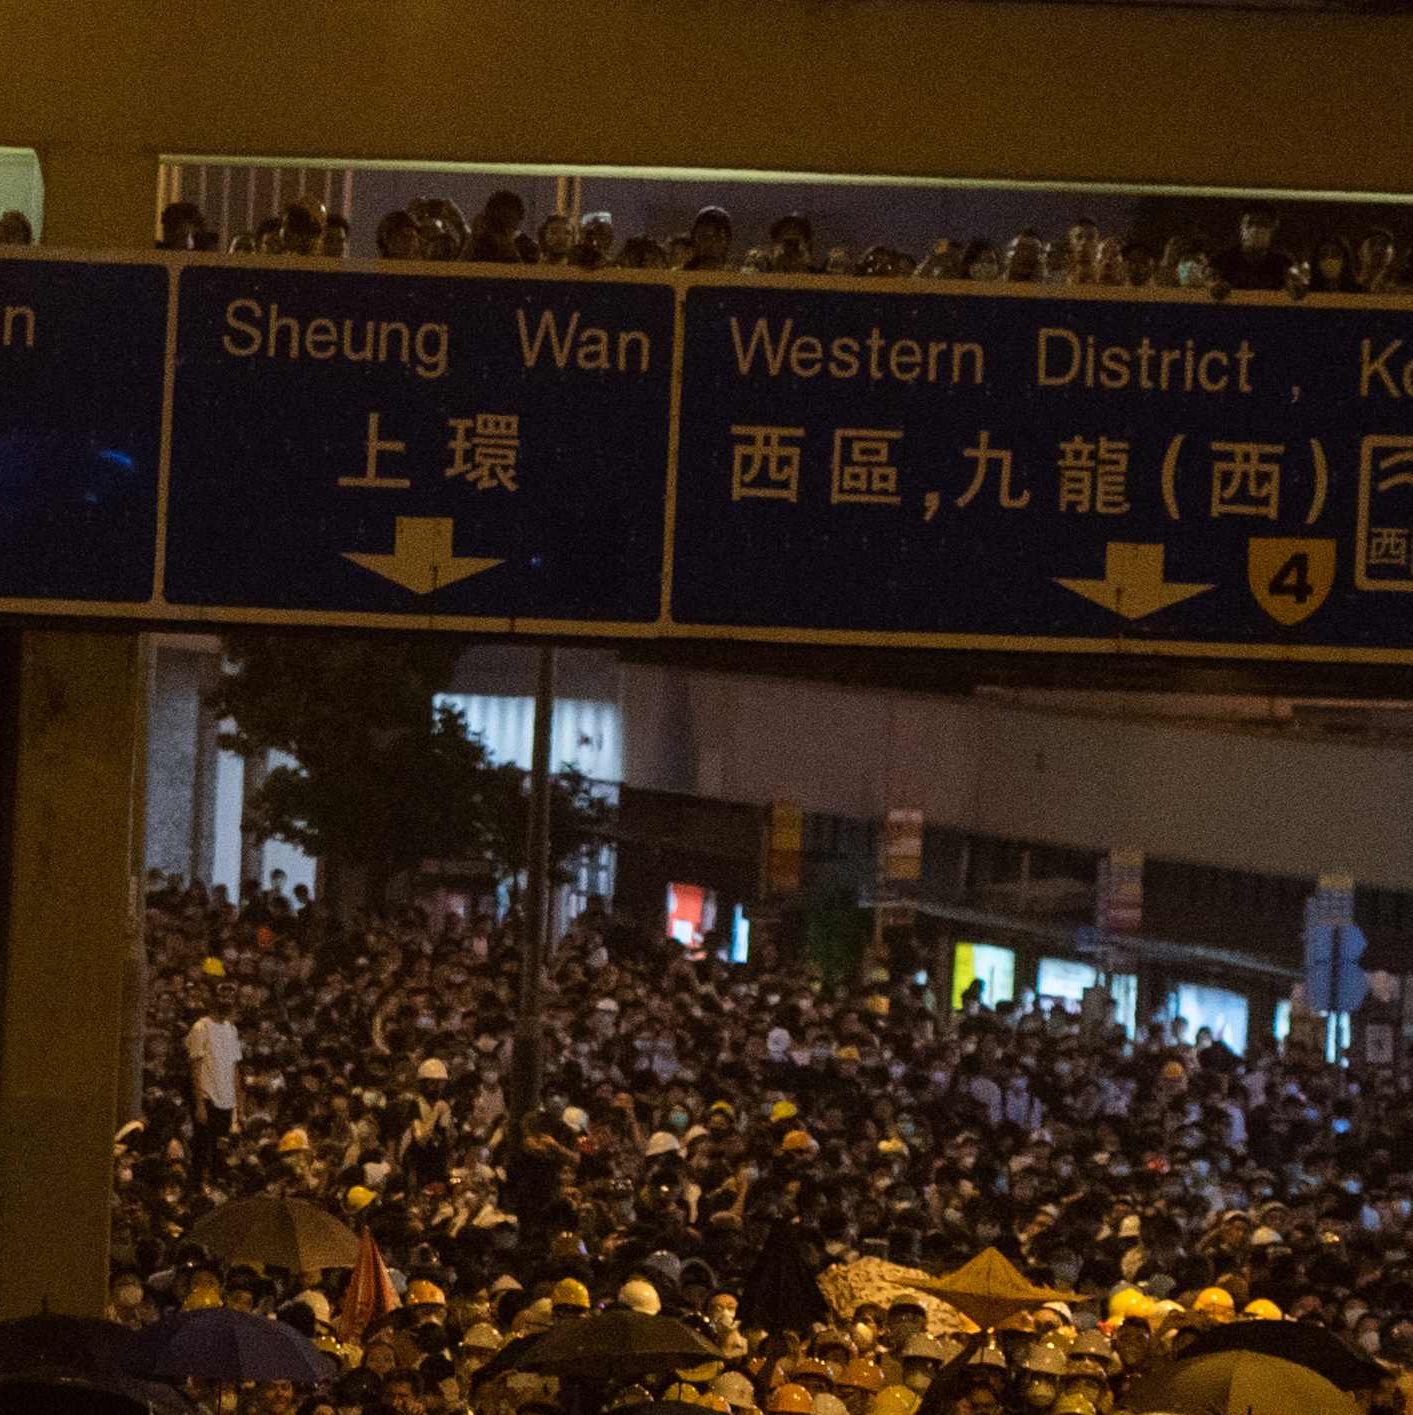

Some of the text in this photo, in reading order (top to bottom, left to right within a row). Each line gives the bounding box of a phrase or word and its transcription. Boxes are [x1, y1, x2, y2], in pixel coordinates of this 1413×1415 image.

[222, 299, 650, 378] Sheung Wan
[729, 316, 985, 385] Western
[1360, 337, 1413, 397] K
[337, 412, 520, 491] 上環
[1268, 553, 1314, 605] 4
